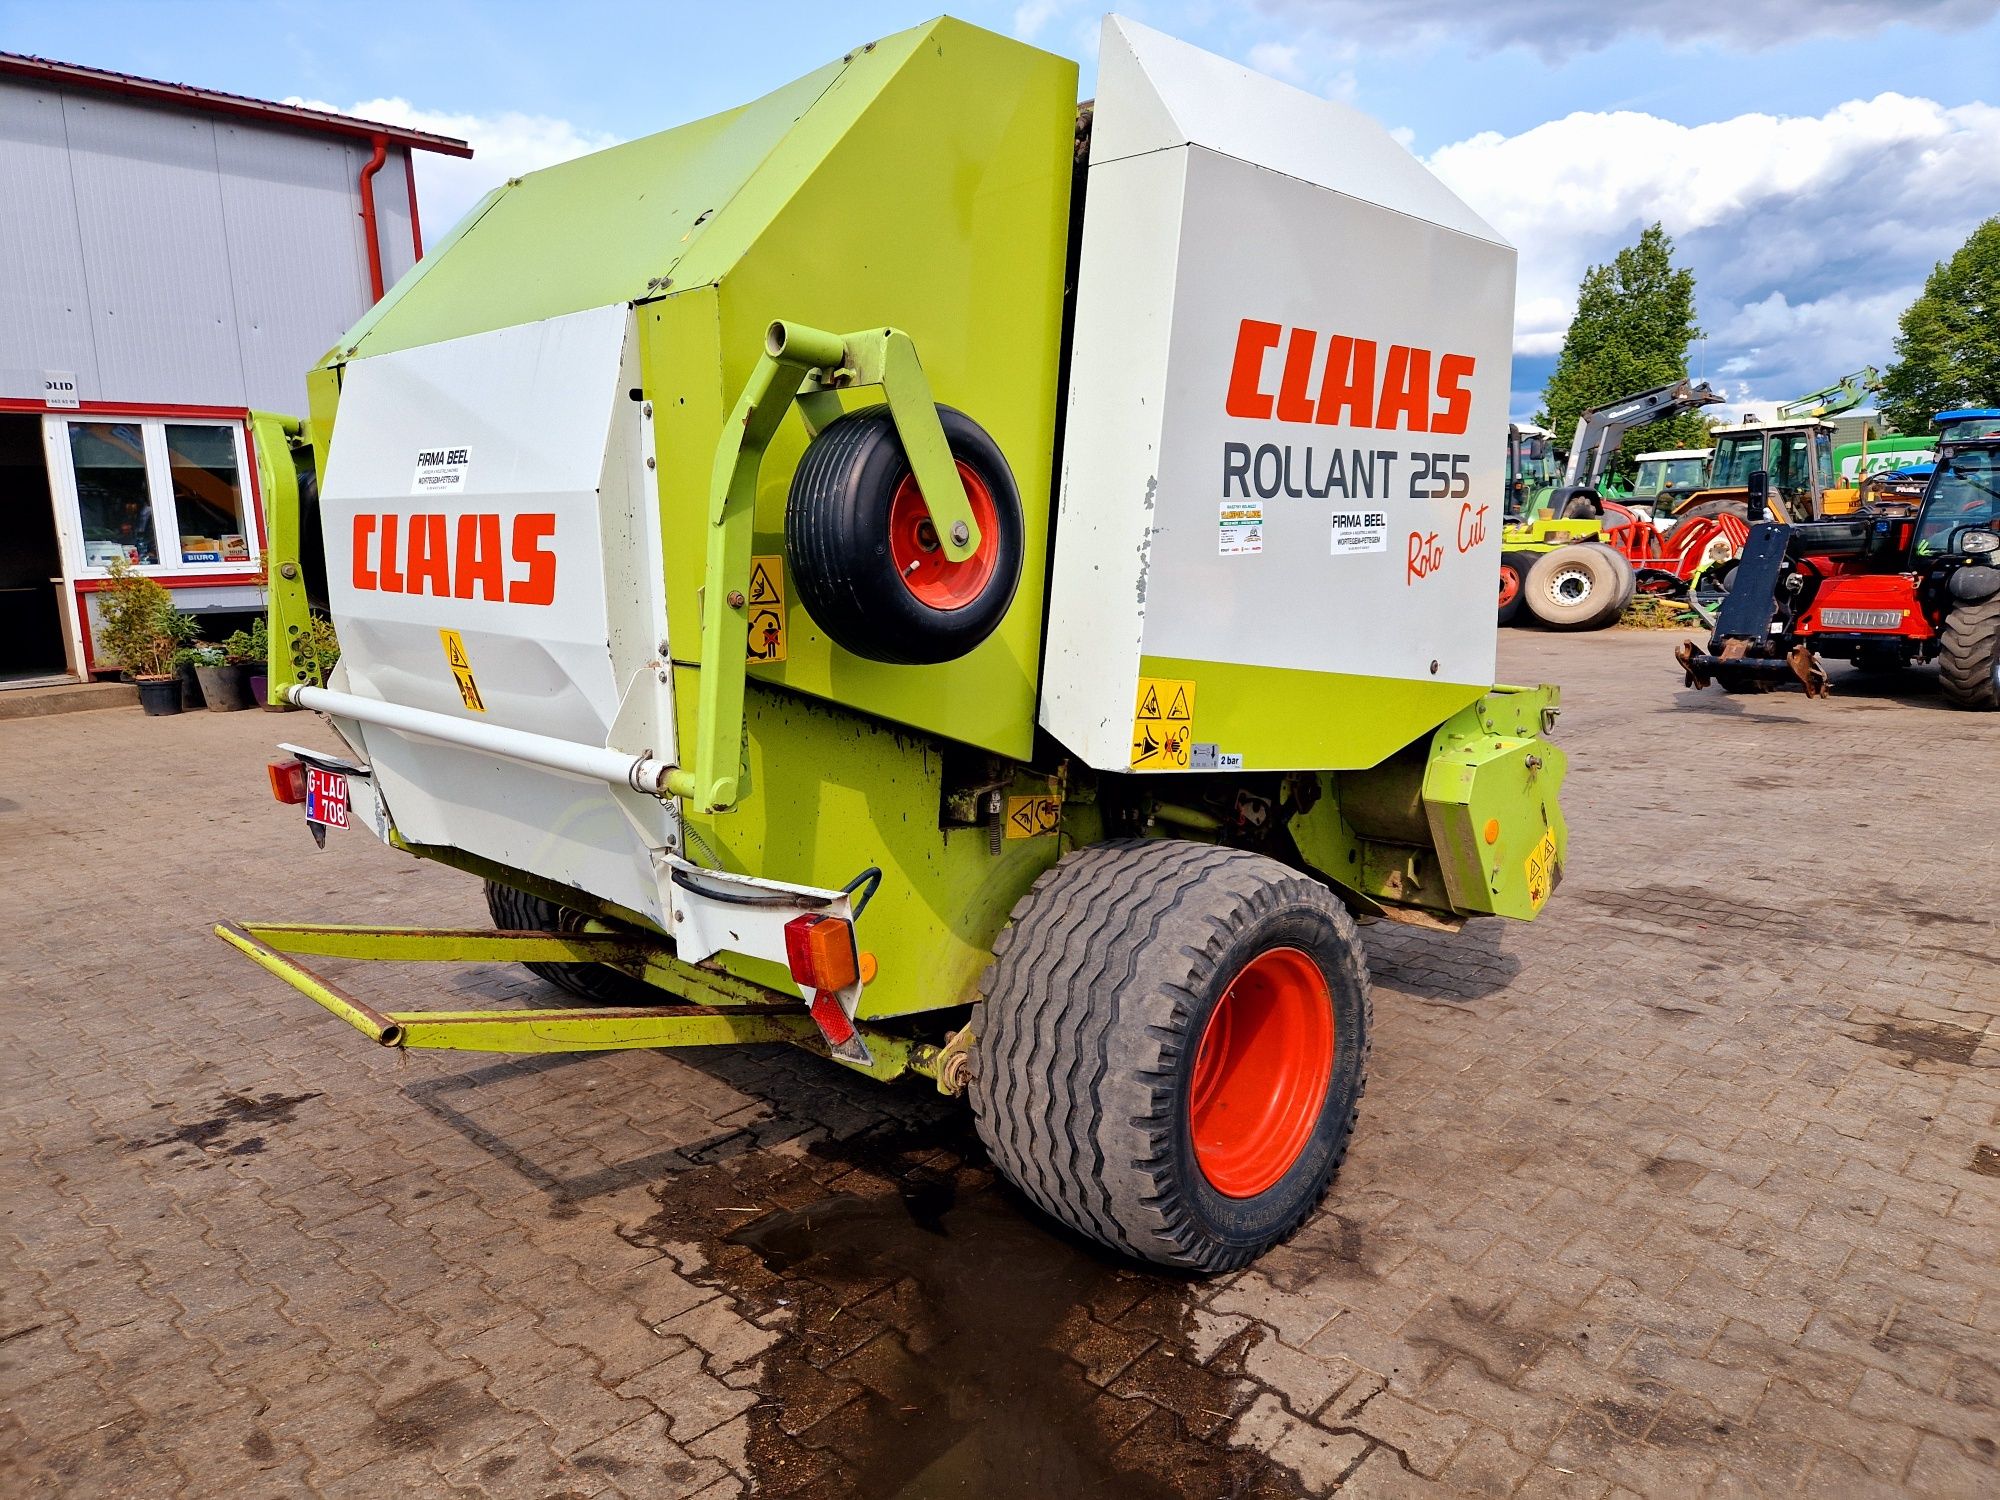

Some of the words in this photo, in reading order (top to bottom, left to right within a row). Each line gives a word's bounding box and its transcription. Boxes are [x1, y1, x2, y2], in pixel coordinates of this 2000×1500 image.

[1225, 318, 1476, 435] CLAAS
[416, 450, 445, 467] FIRMA
[446, 448, 469, 465] BEEL
[1223, 440, 1399, 500] ROLLANT
[1409, 451, 1471, 500] 255
[1332, 514, 1362, 528] FIRMA
[1364, 513, 1386, 527] BEEL
[1406, 530, 1445, 587] Roto
[1456, 502, 1490, 555] Cut
[352, 513, 557, 606] CLAAS
[1823, 611, 1902, 626] MANITOU
[1220, 756, 1226, 765] 2
[1227, 756, 1240, 765] bar
[321, 799, 345, 825] 708
